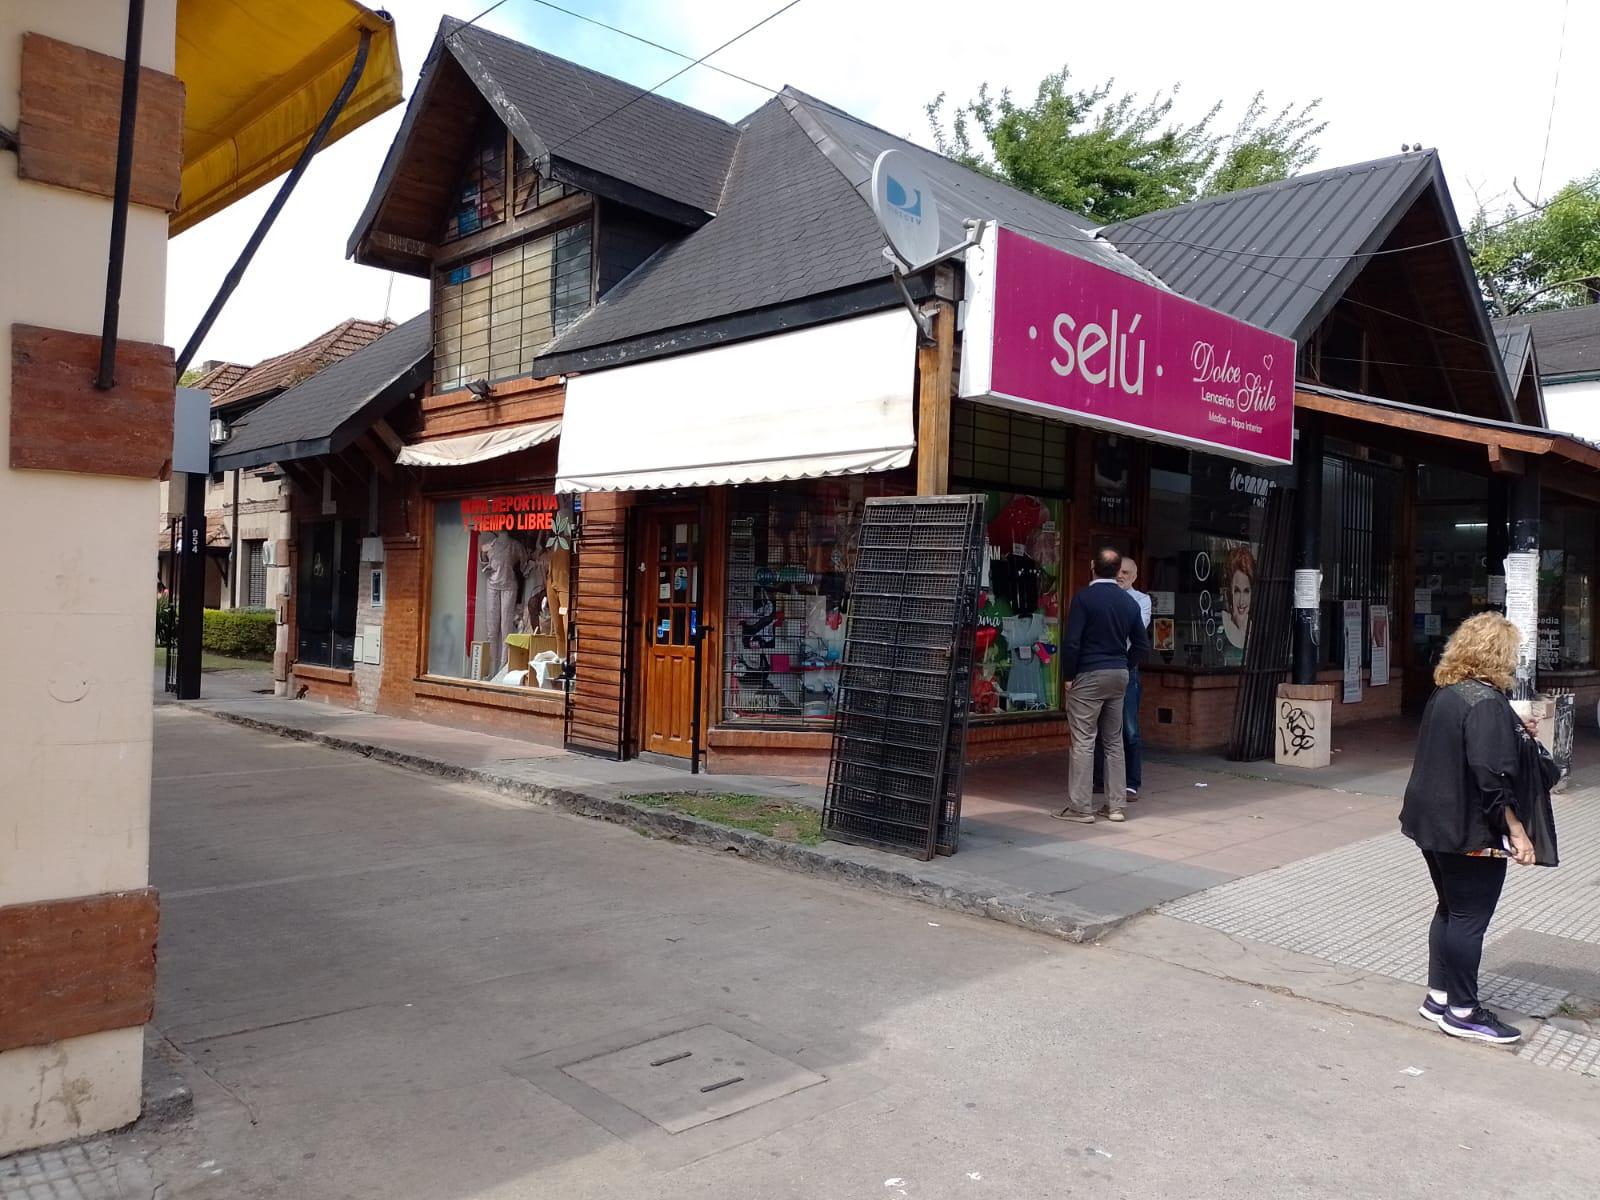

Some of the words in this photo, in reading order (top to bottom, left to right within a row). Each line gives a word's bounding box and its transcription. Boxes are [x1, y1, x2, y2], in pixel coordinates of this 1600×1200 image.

[1051, 308, 1145, 396] selú
[1190, 340, 1241, 383] Dolce
[1236, 372, 1277, 413] Stile
[491, 494, 559, 513] DEPORTIVA
[517, 512, 554, 531] LIBRE
[191, 528, 199, 553] 954
